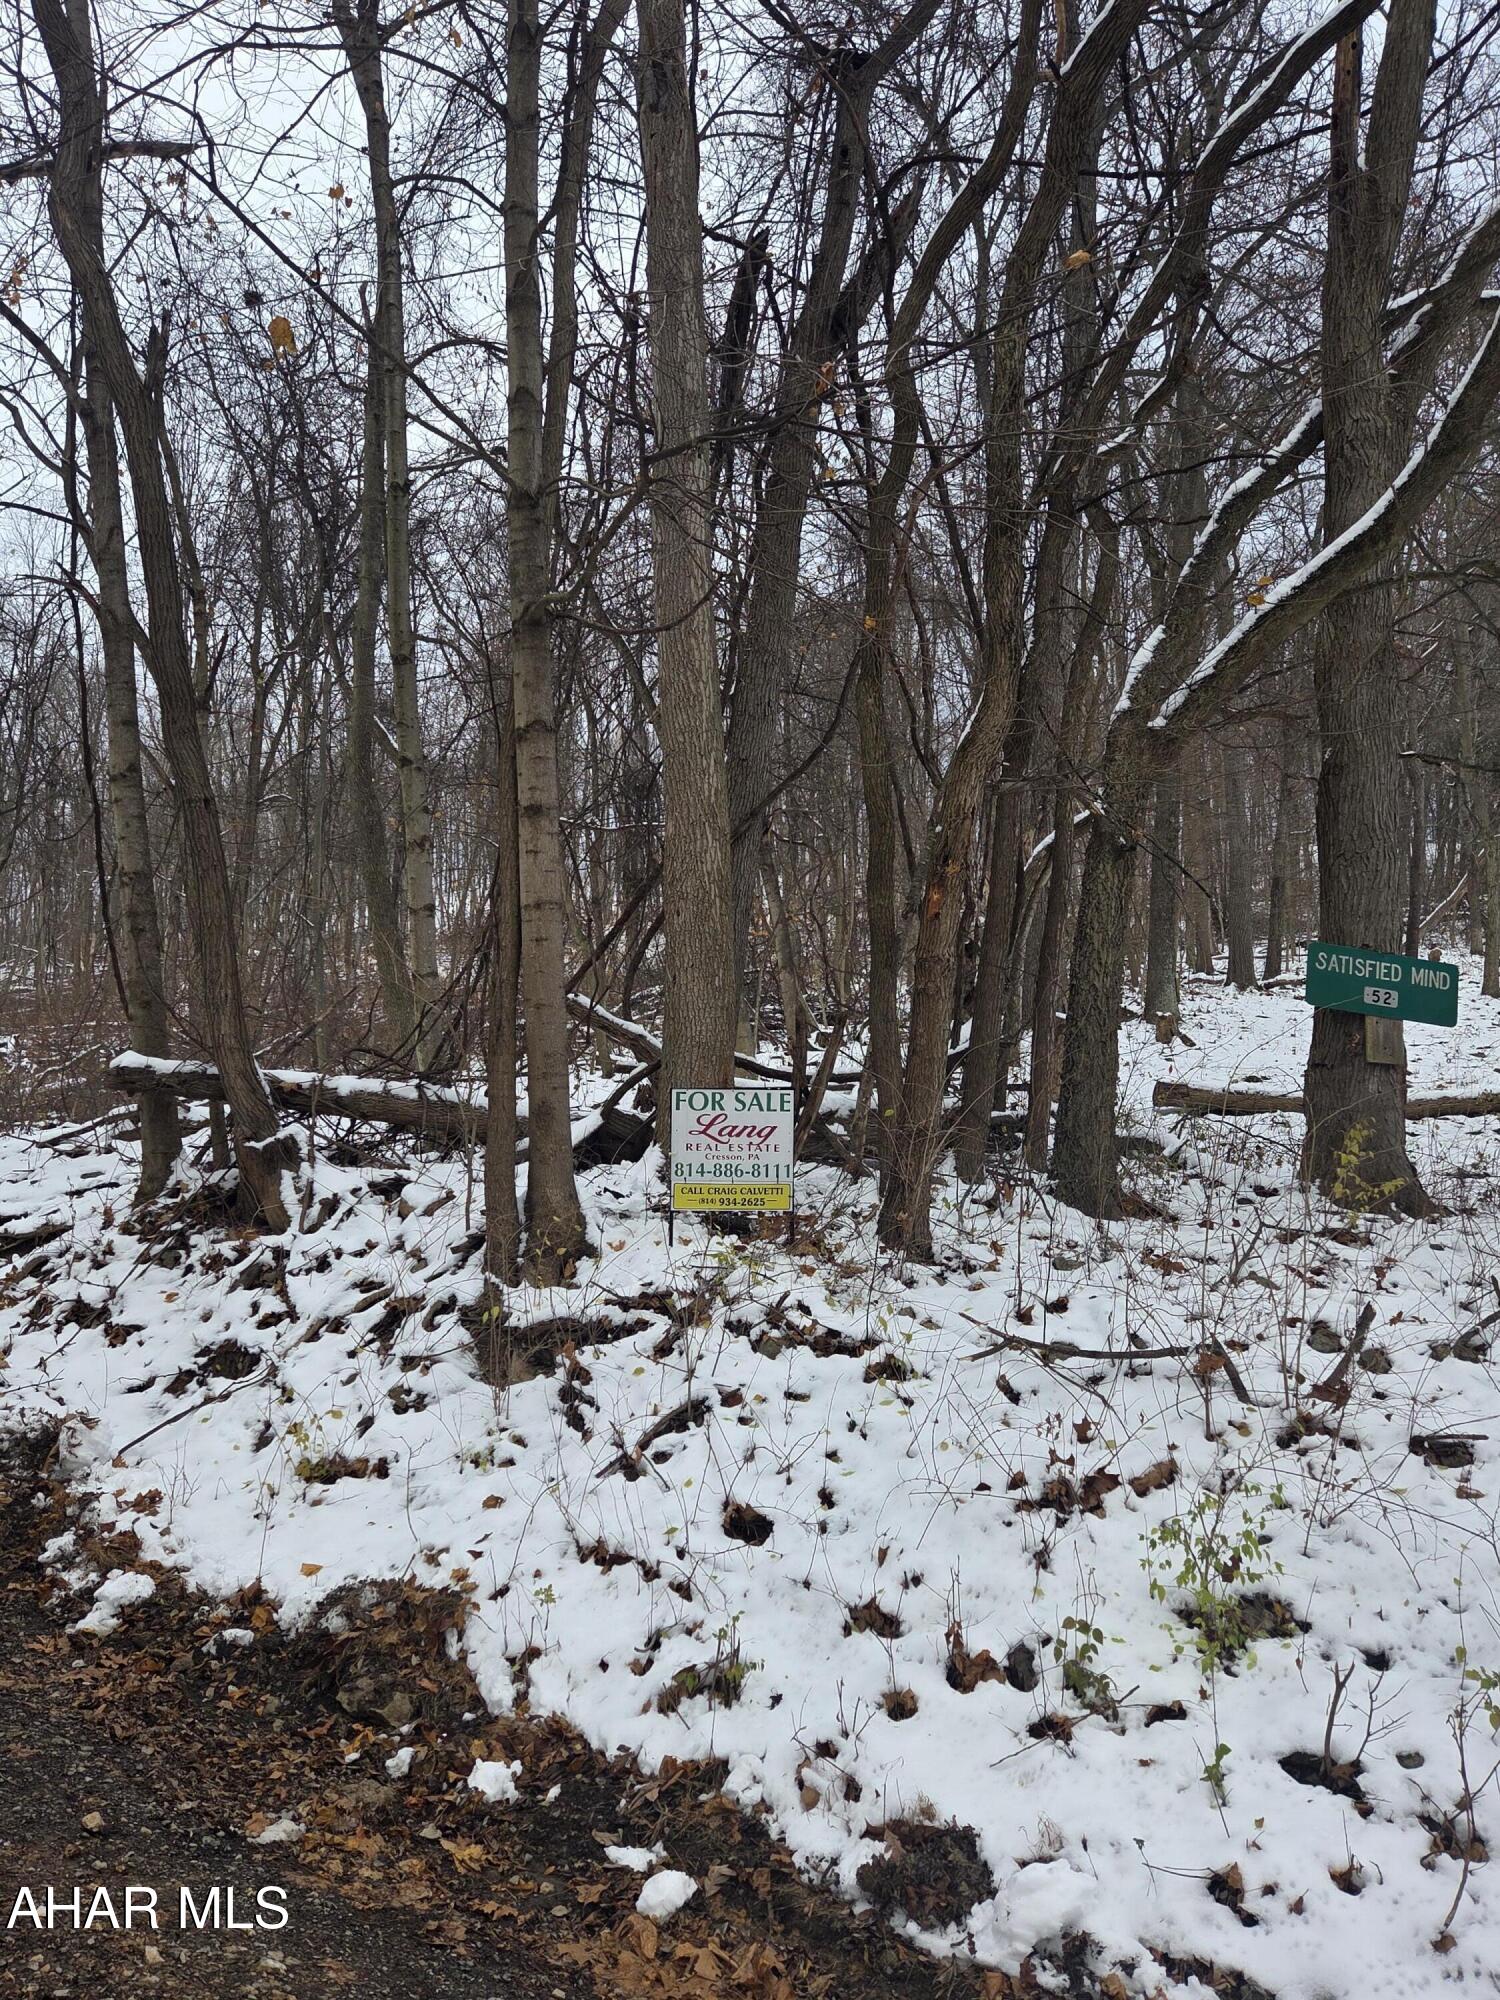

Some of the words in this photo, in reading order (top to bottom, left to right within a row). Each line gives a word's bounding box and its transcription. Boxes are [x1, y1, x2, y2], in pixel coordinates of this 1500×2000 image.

[1315, 952, 1402, 982] SATISFIED
[1411, 966, 1450, 990] MIND
[1371, 990, 1392, 1005] 52
[675, 1091, 725, 1111] FOR
[734, 1092, 791, 1112] SALE
[688, 1113, 778, 1146] Lang
[685, 1143, 721, 1152] REAL
[728, 1143, 780, 1153] ESTATE
[705, 1153, 745, 1161] Cresson,
[748, 1153, 760, 1161] PA
[674, 1162, 791, 1178] 814-886-8111
[680, 1187, 705, 1195] CALL
[707, 1187, 737, 1195] CRAIG
[740, 1187, 784, 1195] CALVETTI
[698, 1197, 717, 1205] (814)
[719, 1197, 766, 1206] 934-2625
